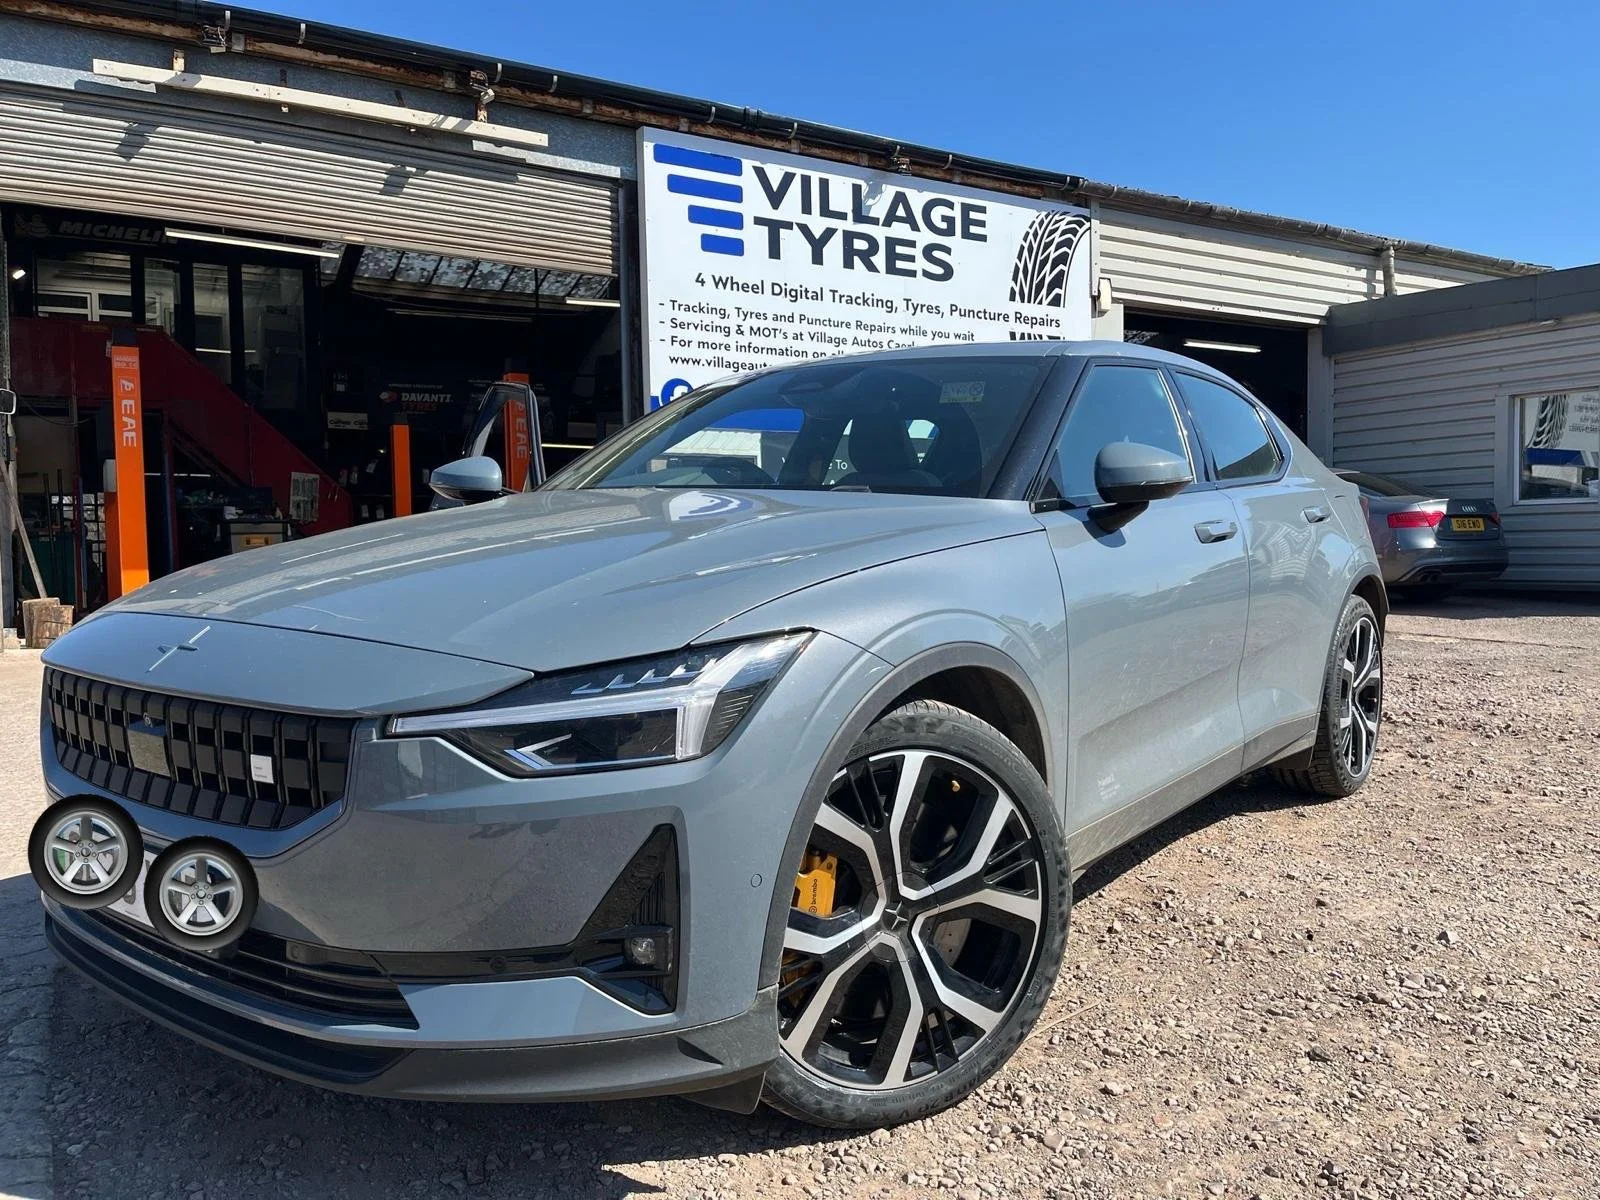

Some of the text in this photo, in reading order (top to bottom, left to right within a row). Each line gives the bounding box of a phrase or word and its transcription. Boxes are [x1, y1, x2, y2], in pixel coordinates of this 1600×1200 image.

[752, 165, 988, 243] VILLAGE
[753, 216, 954, 282] TYRES
[695, 272, 1061, 329] 4 Wheel Digital Tracking, Tyres, Puncture Repairs
[669, 299, 731, 320] Tracking,
[734, 306, 768, 322] Tyres
[772, 312, 795, 324] and
[799, 315, 851, 330] Puncture
[855, 320, 896, 334] Repairs
[899, 323, 928, 337] while
[931, 328, 950, 341] you
[953, 331, 975, 342] wait
[669, 317, 731, 338] Servicing
[735, 324, 745, 337] &
[749, 325, 788, 341] MOT's
[792, 331, 804, 342] at
[808, 331, 848, 348] Village
[852, 336, 884, 349] Autos
[669, 356, 772, 373] www.villageaut
[670, 335, 693, 348] For
[697, 340, 731, 352] more
[735, 341, 808, 359] information
[812, 351, 827, 359] on
[401, 392, 452, 403] DAVANTI
[120, 399, 137, 448] EAE
[516, 417, 529, 459] EAE
[835, 459, 848, 470] To
[810, 878, 818, 906] brembo
